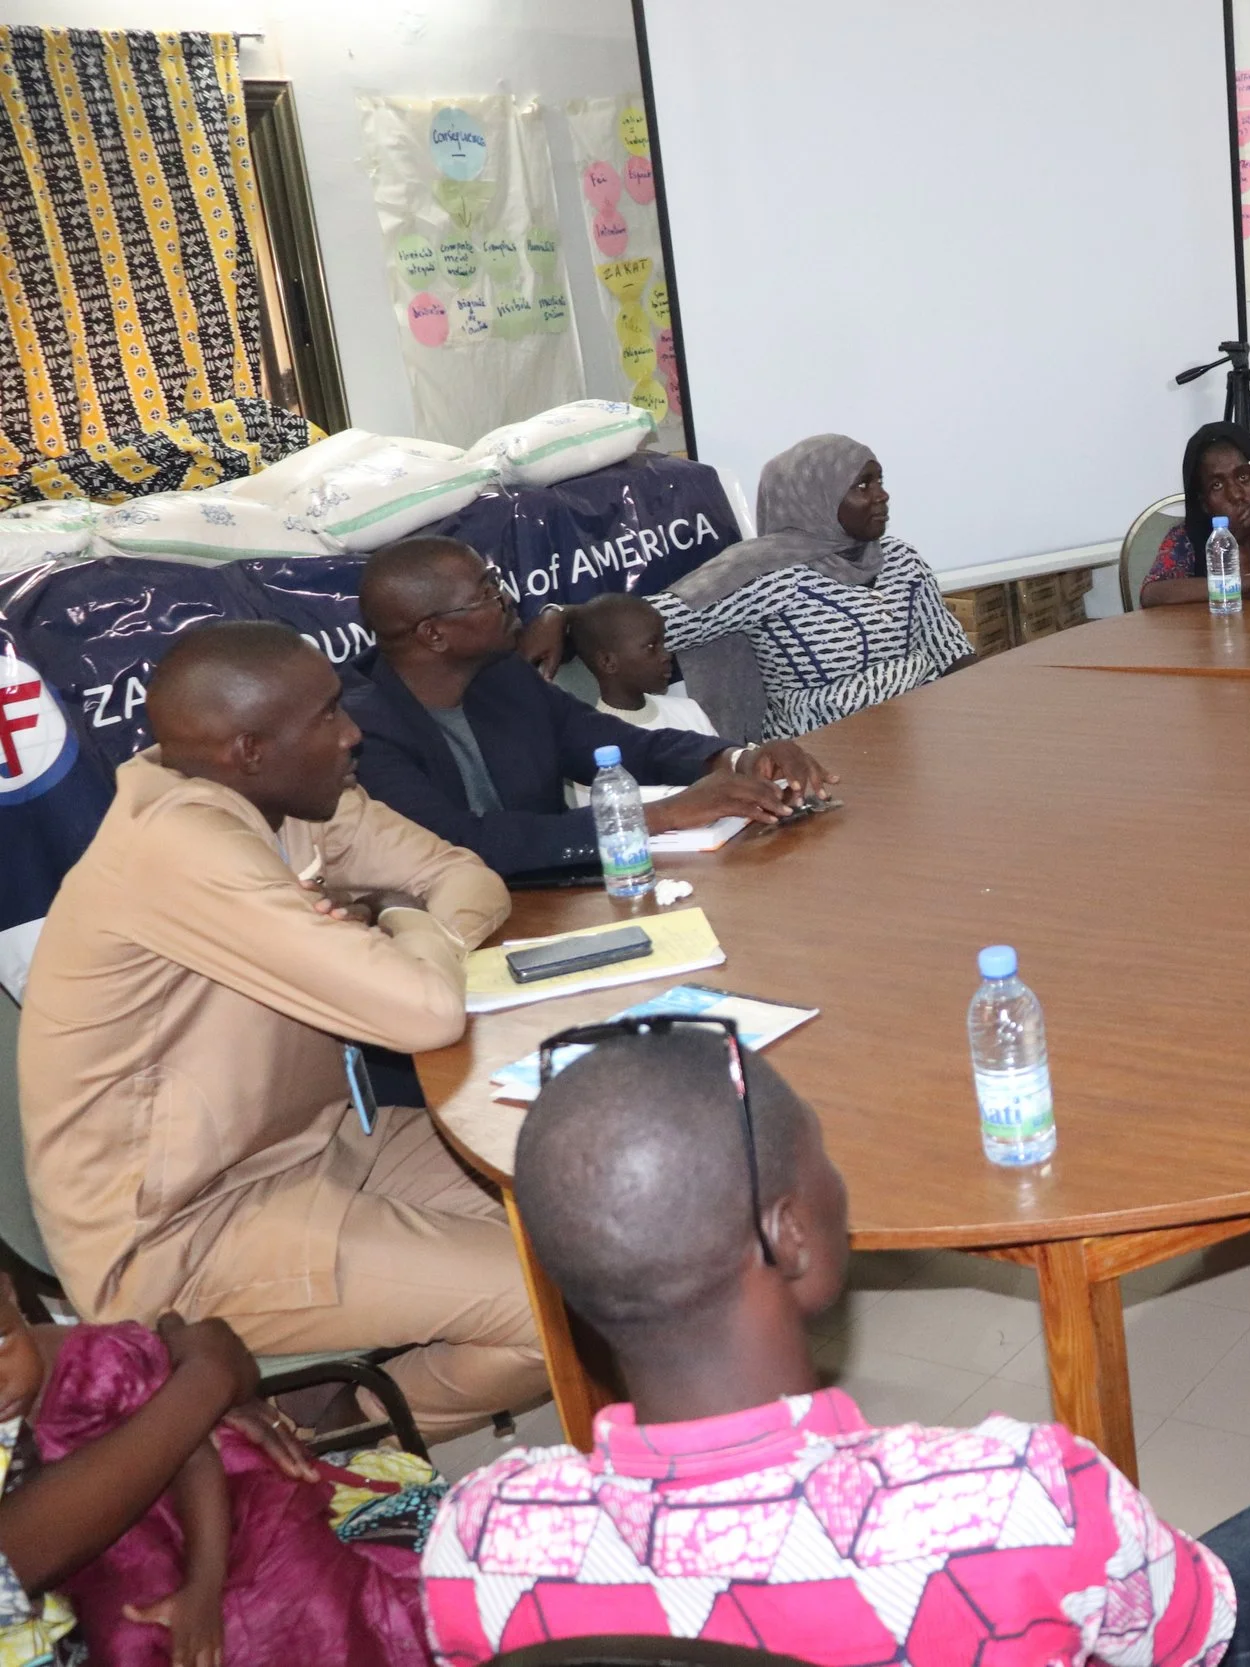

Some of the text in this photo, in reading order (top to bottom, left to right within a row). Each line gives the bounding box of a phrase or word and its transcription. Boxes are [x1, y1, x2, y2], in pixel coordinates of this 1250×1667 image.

[604, 258, 648, 280] ZAKAT
[527, 512, 719, 596] of AMERICA
